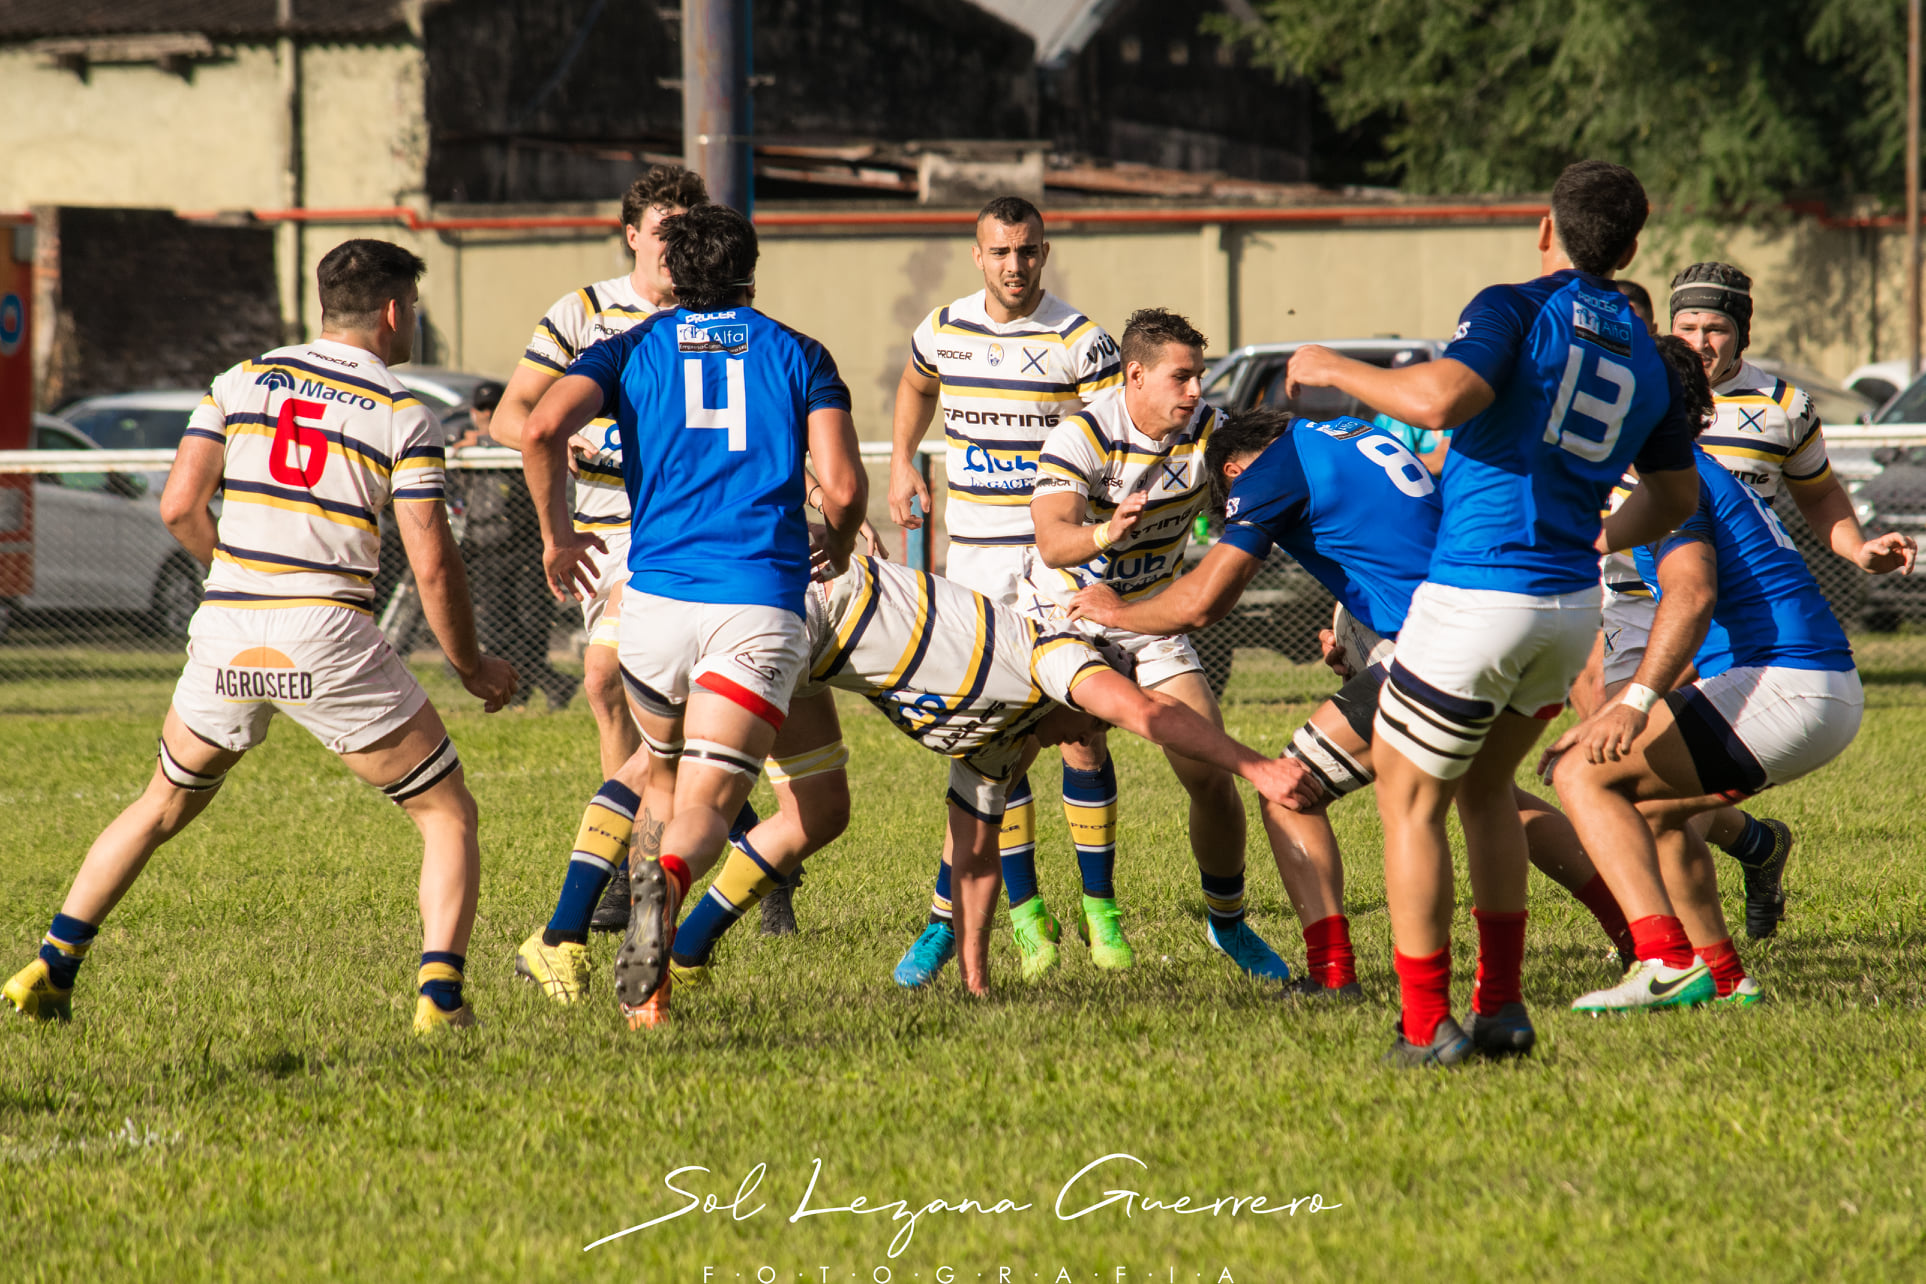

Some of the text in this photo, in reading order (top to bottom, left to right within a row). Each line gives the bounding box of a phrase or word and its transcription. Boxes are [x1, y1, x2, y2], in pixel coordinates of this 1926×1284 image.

[713, 330, 744, 345] Alfa
[307, 351, 358, 369] PROCER
[936, 349, 973, 361] PROCER
[299, 378, 377, 411] Macro
[684, 358, 747, 452] 4
[1542, 343, 1637, 463] 13
[268, 397, 328, 489] 6
[1356, 434, 1436, 498] 8
[215, 668, 313, 700] AGROSEED
